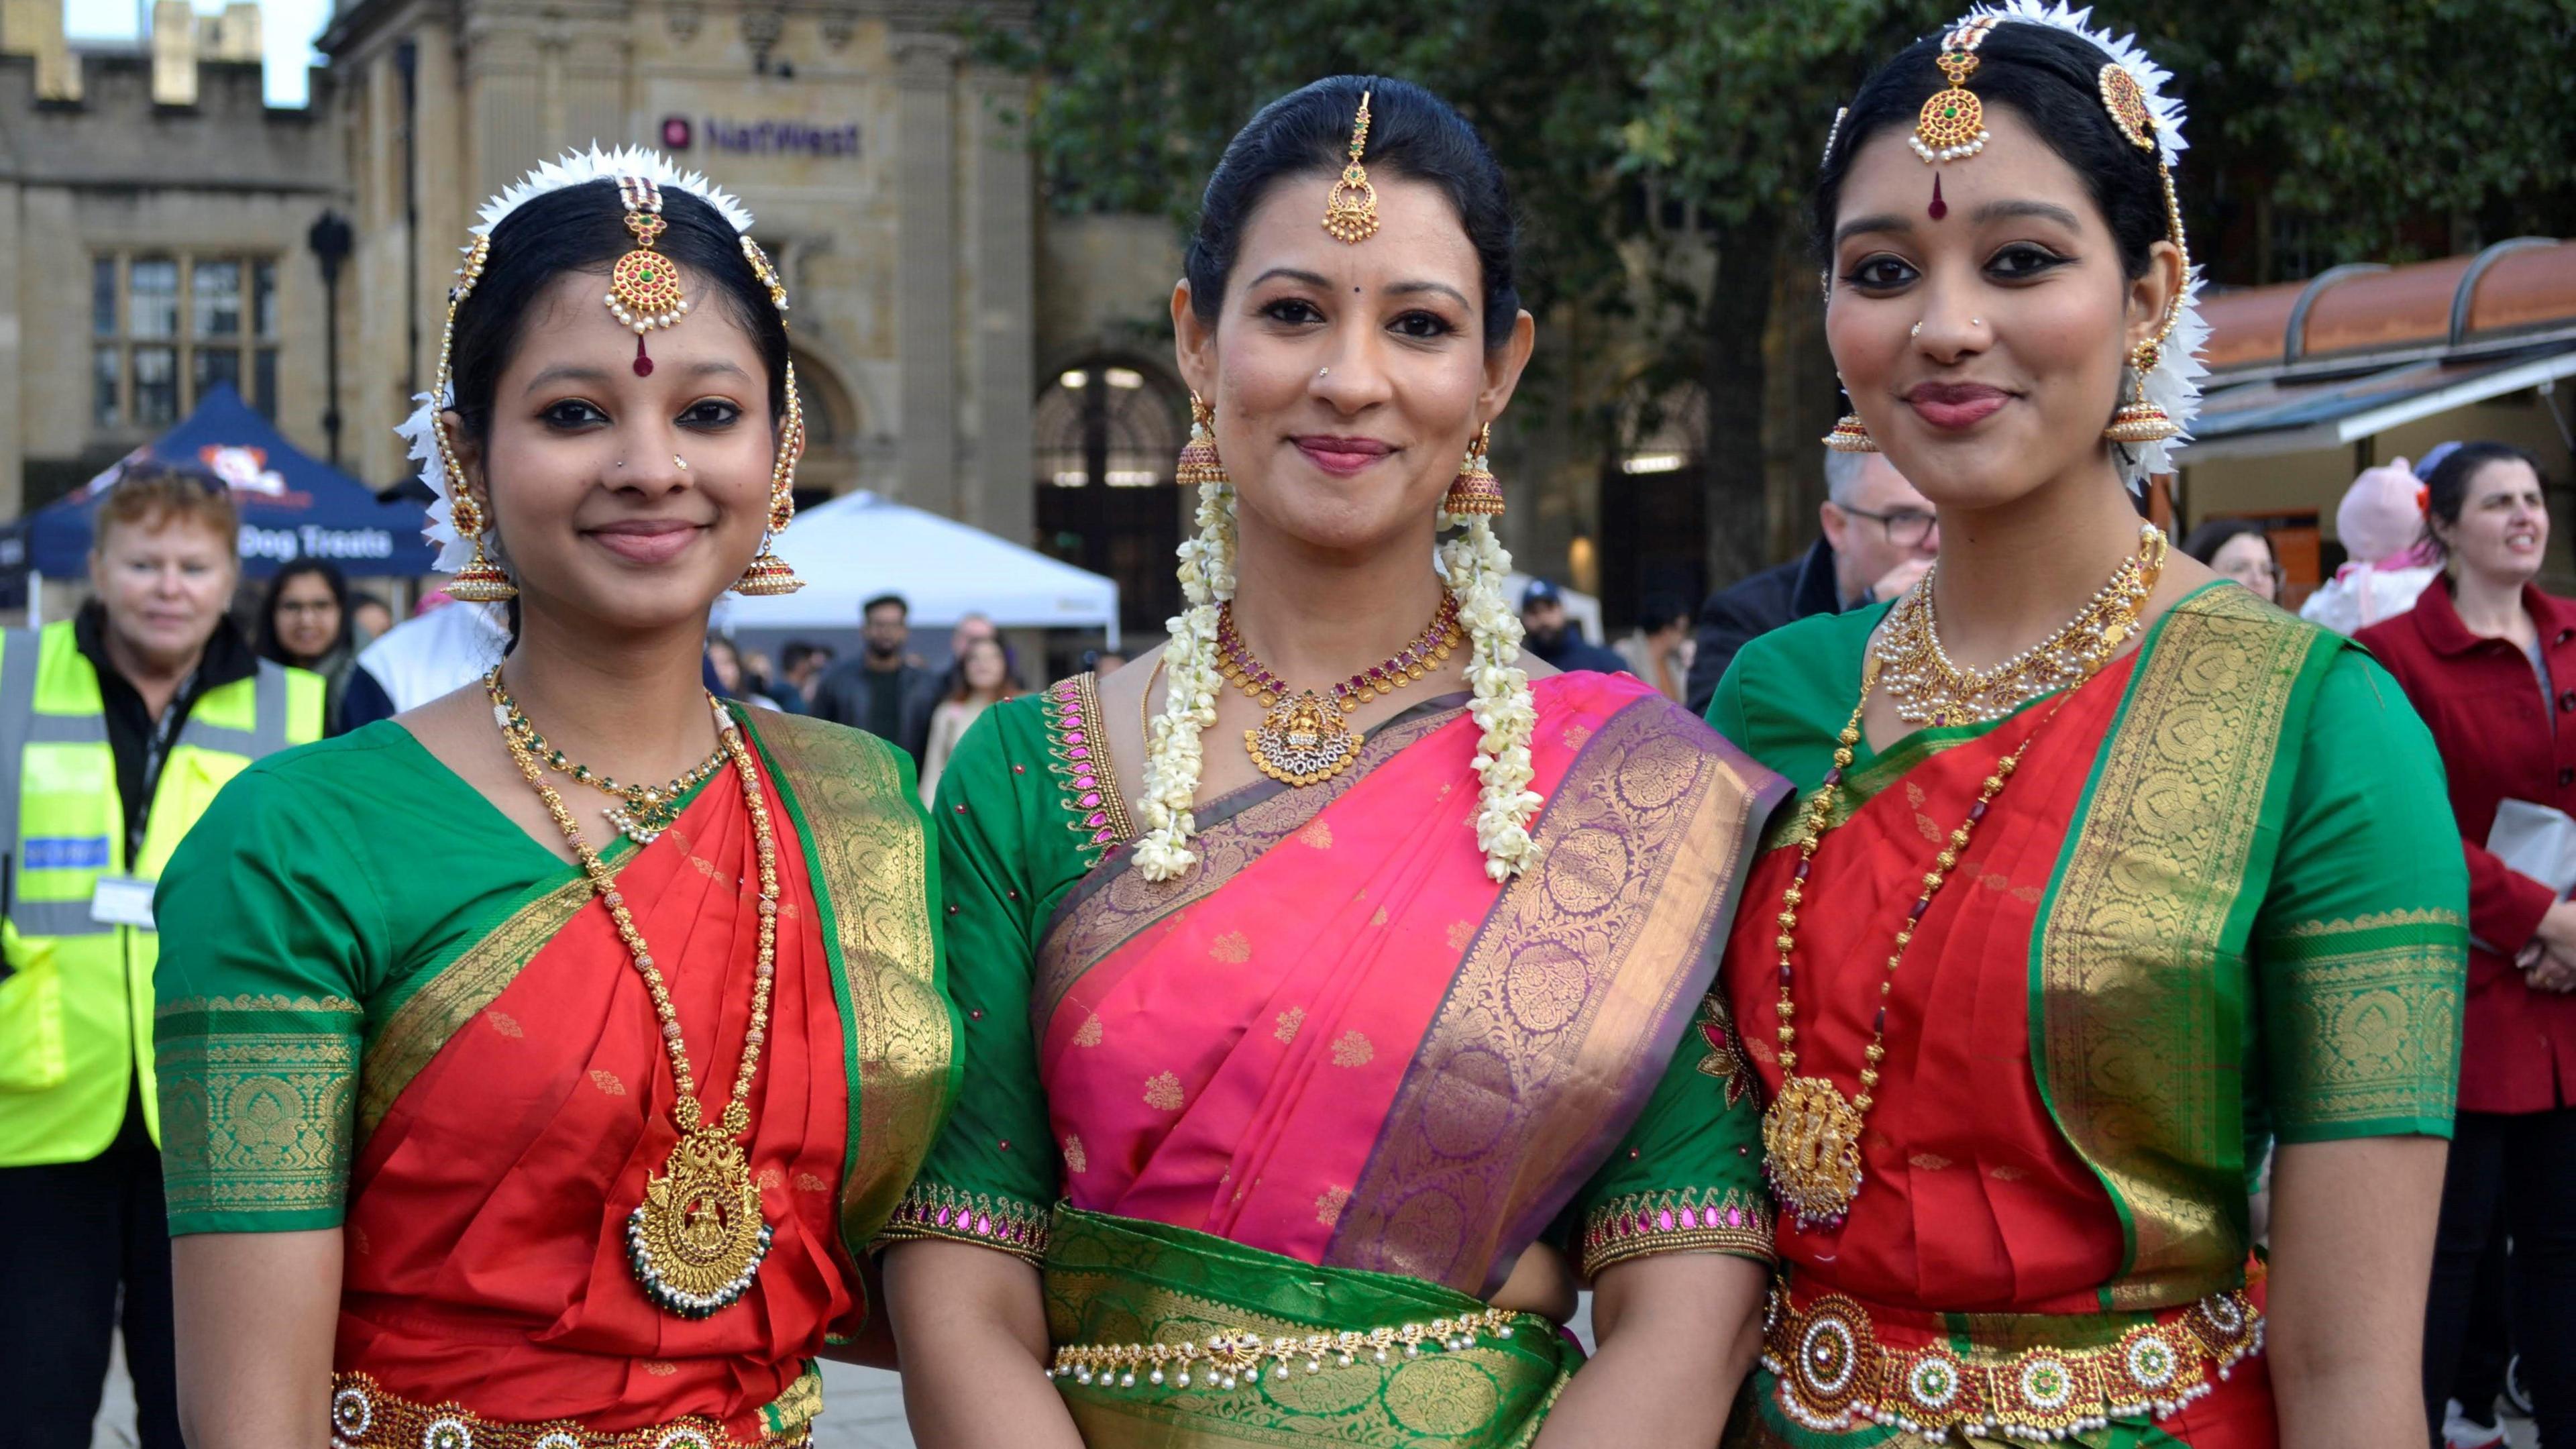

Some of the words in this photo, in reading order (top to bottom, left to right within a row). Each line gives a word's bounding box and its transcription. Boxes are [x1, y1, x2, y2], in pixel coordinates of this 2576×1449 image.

[705, 120, 859, 155] NatWest
[238, 525, 298, 563] Dog
[301, 525, 392, 558] Treats
